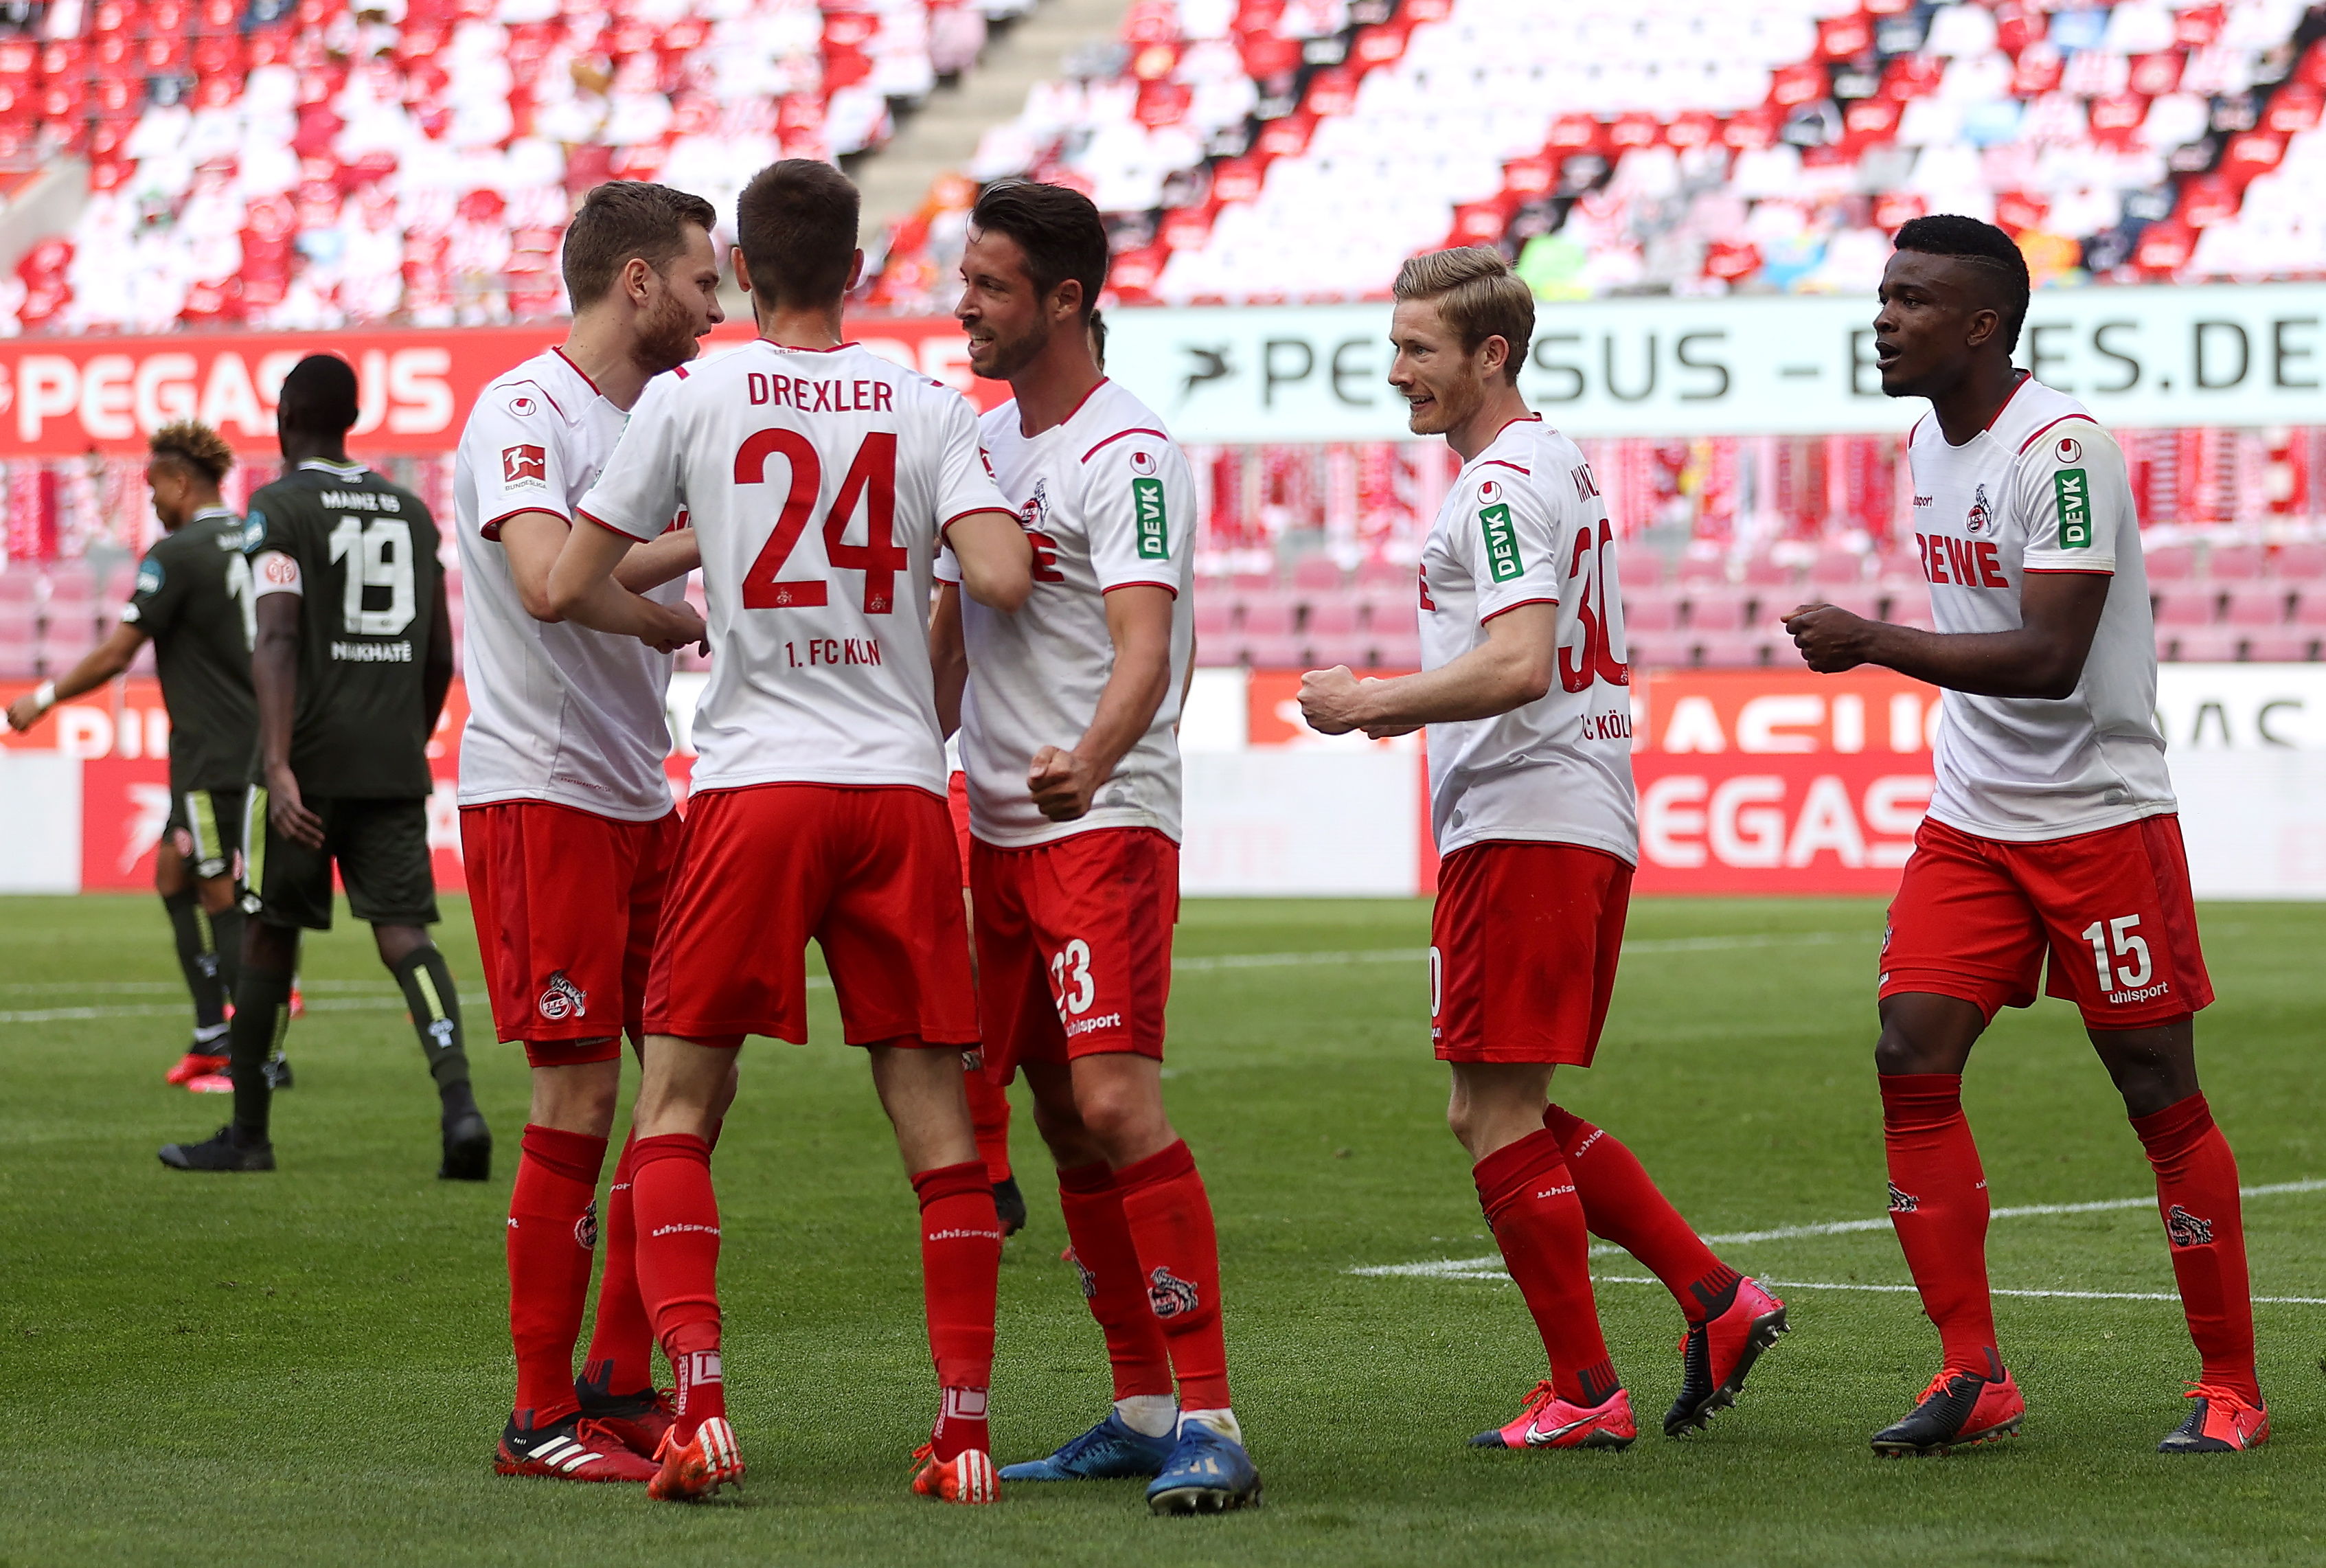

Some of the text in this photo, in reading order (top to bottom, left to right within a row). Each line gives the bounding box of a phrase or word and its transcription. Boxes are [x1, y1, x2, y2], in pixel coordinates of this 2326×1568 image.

[748, 373, 893, 413] DREXLER
[1262, 334, 1732, 408] PESUS
[1849, 318, 2324, 397] ES.DE
[320, 490, 379, 511] MAINZ
[505, 479, 547, 490] BUNDESLIGA
[2062, 477, 2084, 543] DEVK
[734, 428, 908, 614] 24
[1140, 486, 1162, 554] DEVK
[1486, 511, 1516, 578] DEVK
[328, 515, 417, 635] 19
[1915, 533, 2009, 589] REWE
[1558, 519, 1629, 694] 30
[786, 636, 881, 668] 1. FC KLN
[1639, 773, 1938, 868] EGAS
[1051, 938, 1095, 1025] 23
[2082, 913, 2152, 992] 15
[1067, 1012, 1121, 1038] uhlsport
[2109, 981, 2169, 1003] uhlsport
[652, 1223, 721, 1237] uhlspor
[928, 1228, 1000, 1241] uhlspor
